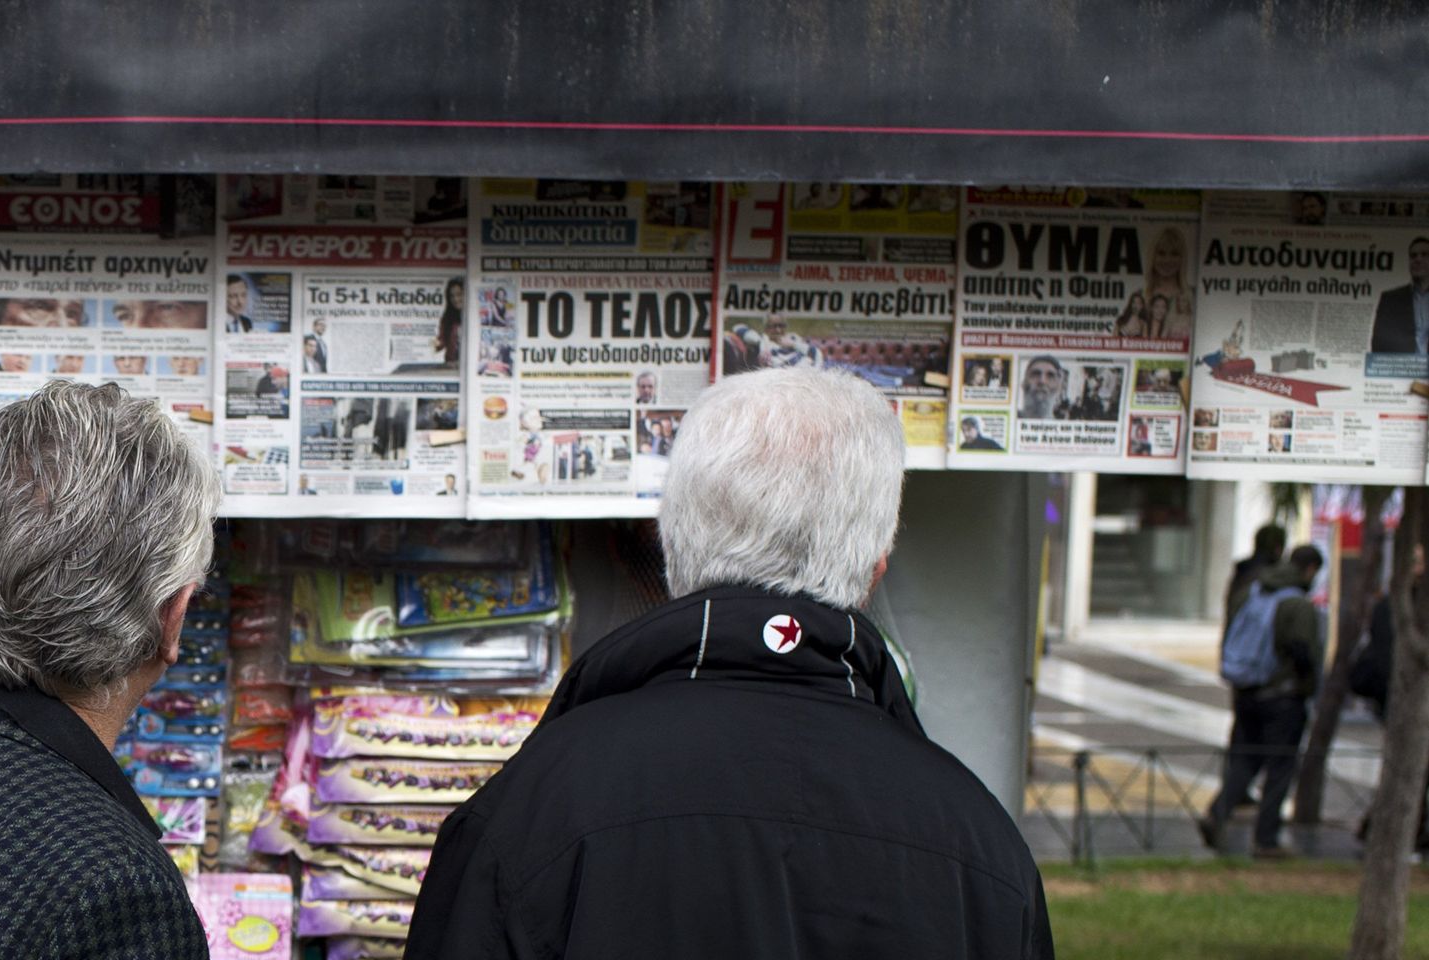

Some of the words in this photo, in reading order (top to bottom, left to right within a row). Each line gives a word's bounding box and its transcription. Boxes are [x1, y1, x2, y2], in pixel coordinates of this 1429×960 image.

[227, 233, 374, 259] ΕΛΕΥΘΕΡΟΣ
[490, 220, 627, 246] δημοκρατία
[965, 221, 1144, 275] ΘΥΜΑ
[1204, 238, 1394, 277] Αυτοδυναμία
[105, 251, 209, 278] αρχηγών
[307, 287, 330, 305] Τα
[335, 287, 370, 305] 5+1
[376, 286, 444, 306] κλειδιά
[963, 271, 1045, 300] απάτης
[1202, 275, 1231, 295] για
[1236, 274, 1302, 297] μεγάλη
[1307, 275, 1372, 299] αλλαγή
[724, 283, 843, 315] Απέραντο
[851, 286, 956, 318] κρεβάτι!
[521, 291, 575, 338] ΤΟ
[584, 291, 712, 338] ΤΕΛΟΣ
[521, 346, 556, 364] των
[562, 342, 712, 366] ψευδαισθήσεων
